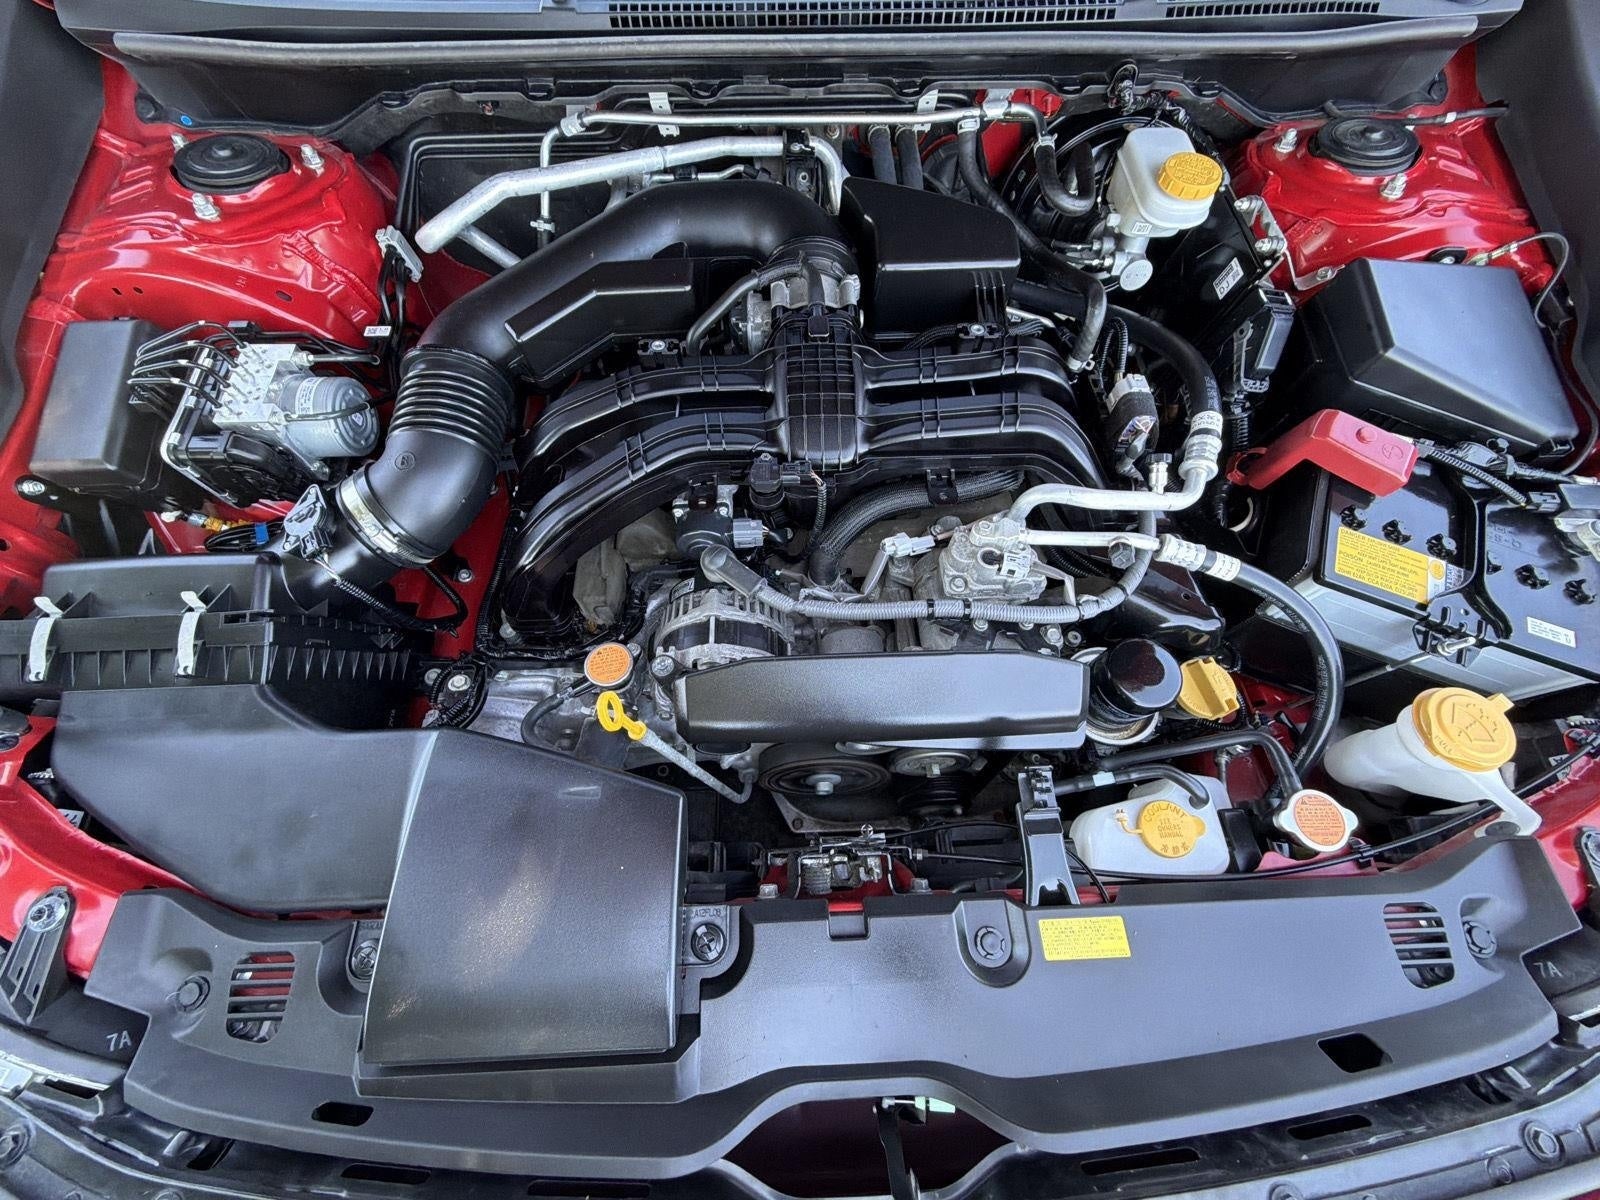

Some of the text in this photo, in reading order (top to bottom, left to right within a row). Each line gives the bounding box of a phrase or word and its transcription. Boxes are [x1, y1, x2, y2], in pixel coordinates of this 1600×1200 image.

[1143, 803, 1187, 822] COOLANT
[1532, 960, 1563, 979] 7A
[106, 1030, 132, 1052] 7A
